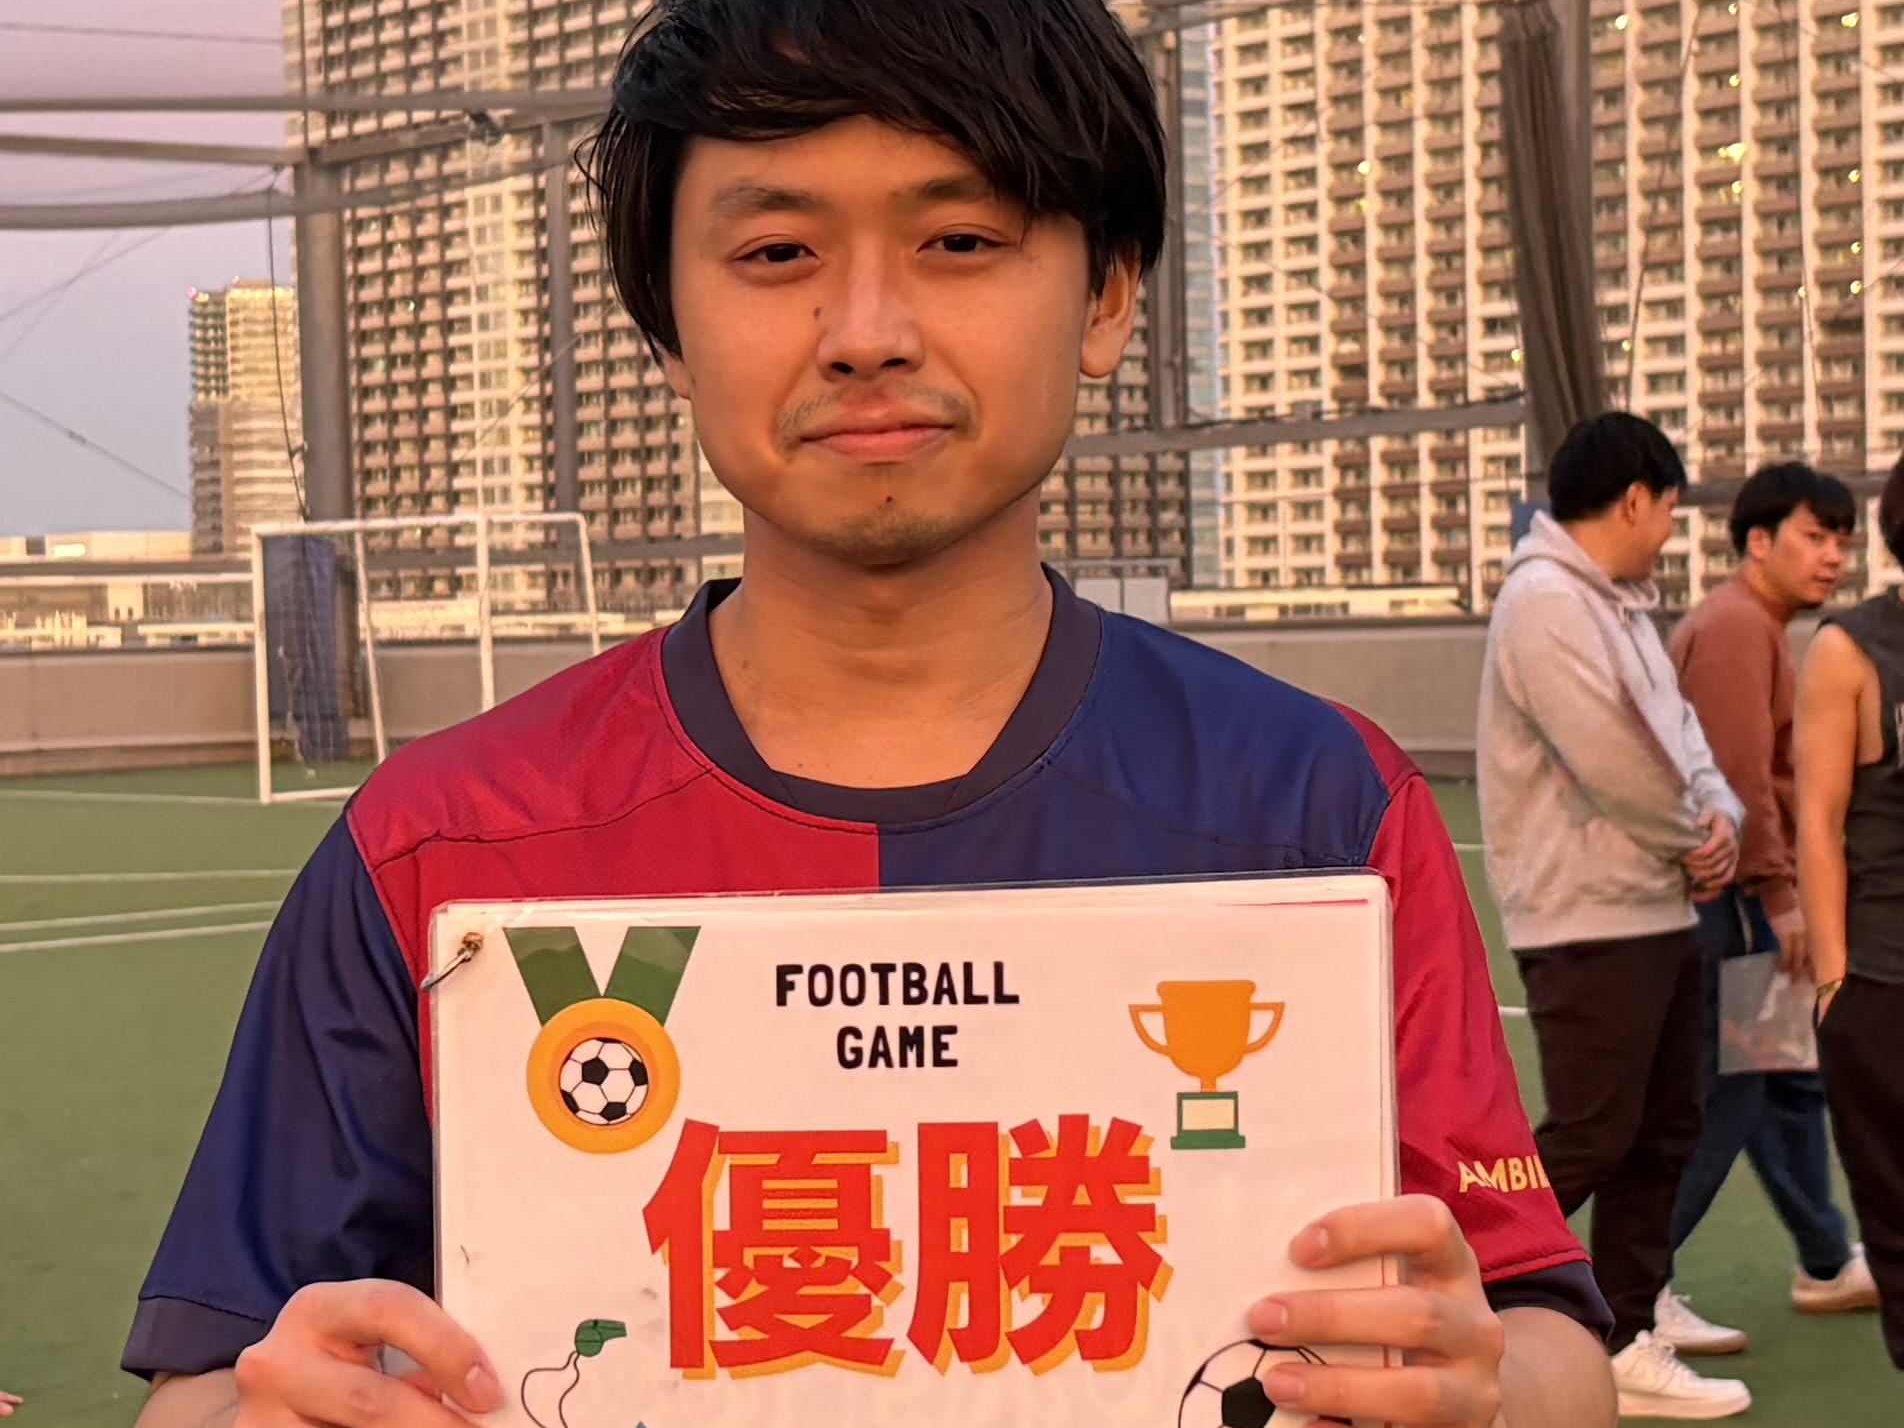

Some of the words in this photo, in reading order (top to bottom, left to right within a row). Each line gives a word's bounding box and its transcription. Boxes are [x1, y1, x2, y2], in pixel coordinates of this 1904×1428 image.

[775, 961, 1020, 1007] FOOTBALL
[836, 1025, 958, 1070] GAME
[642, 1114, 1173, 1379] 優勝
